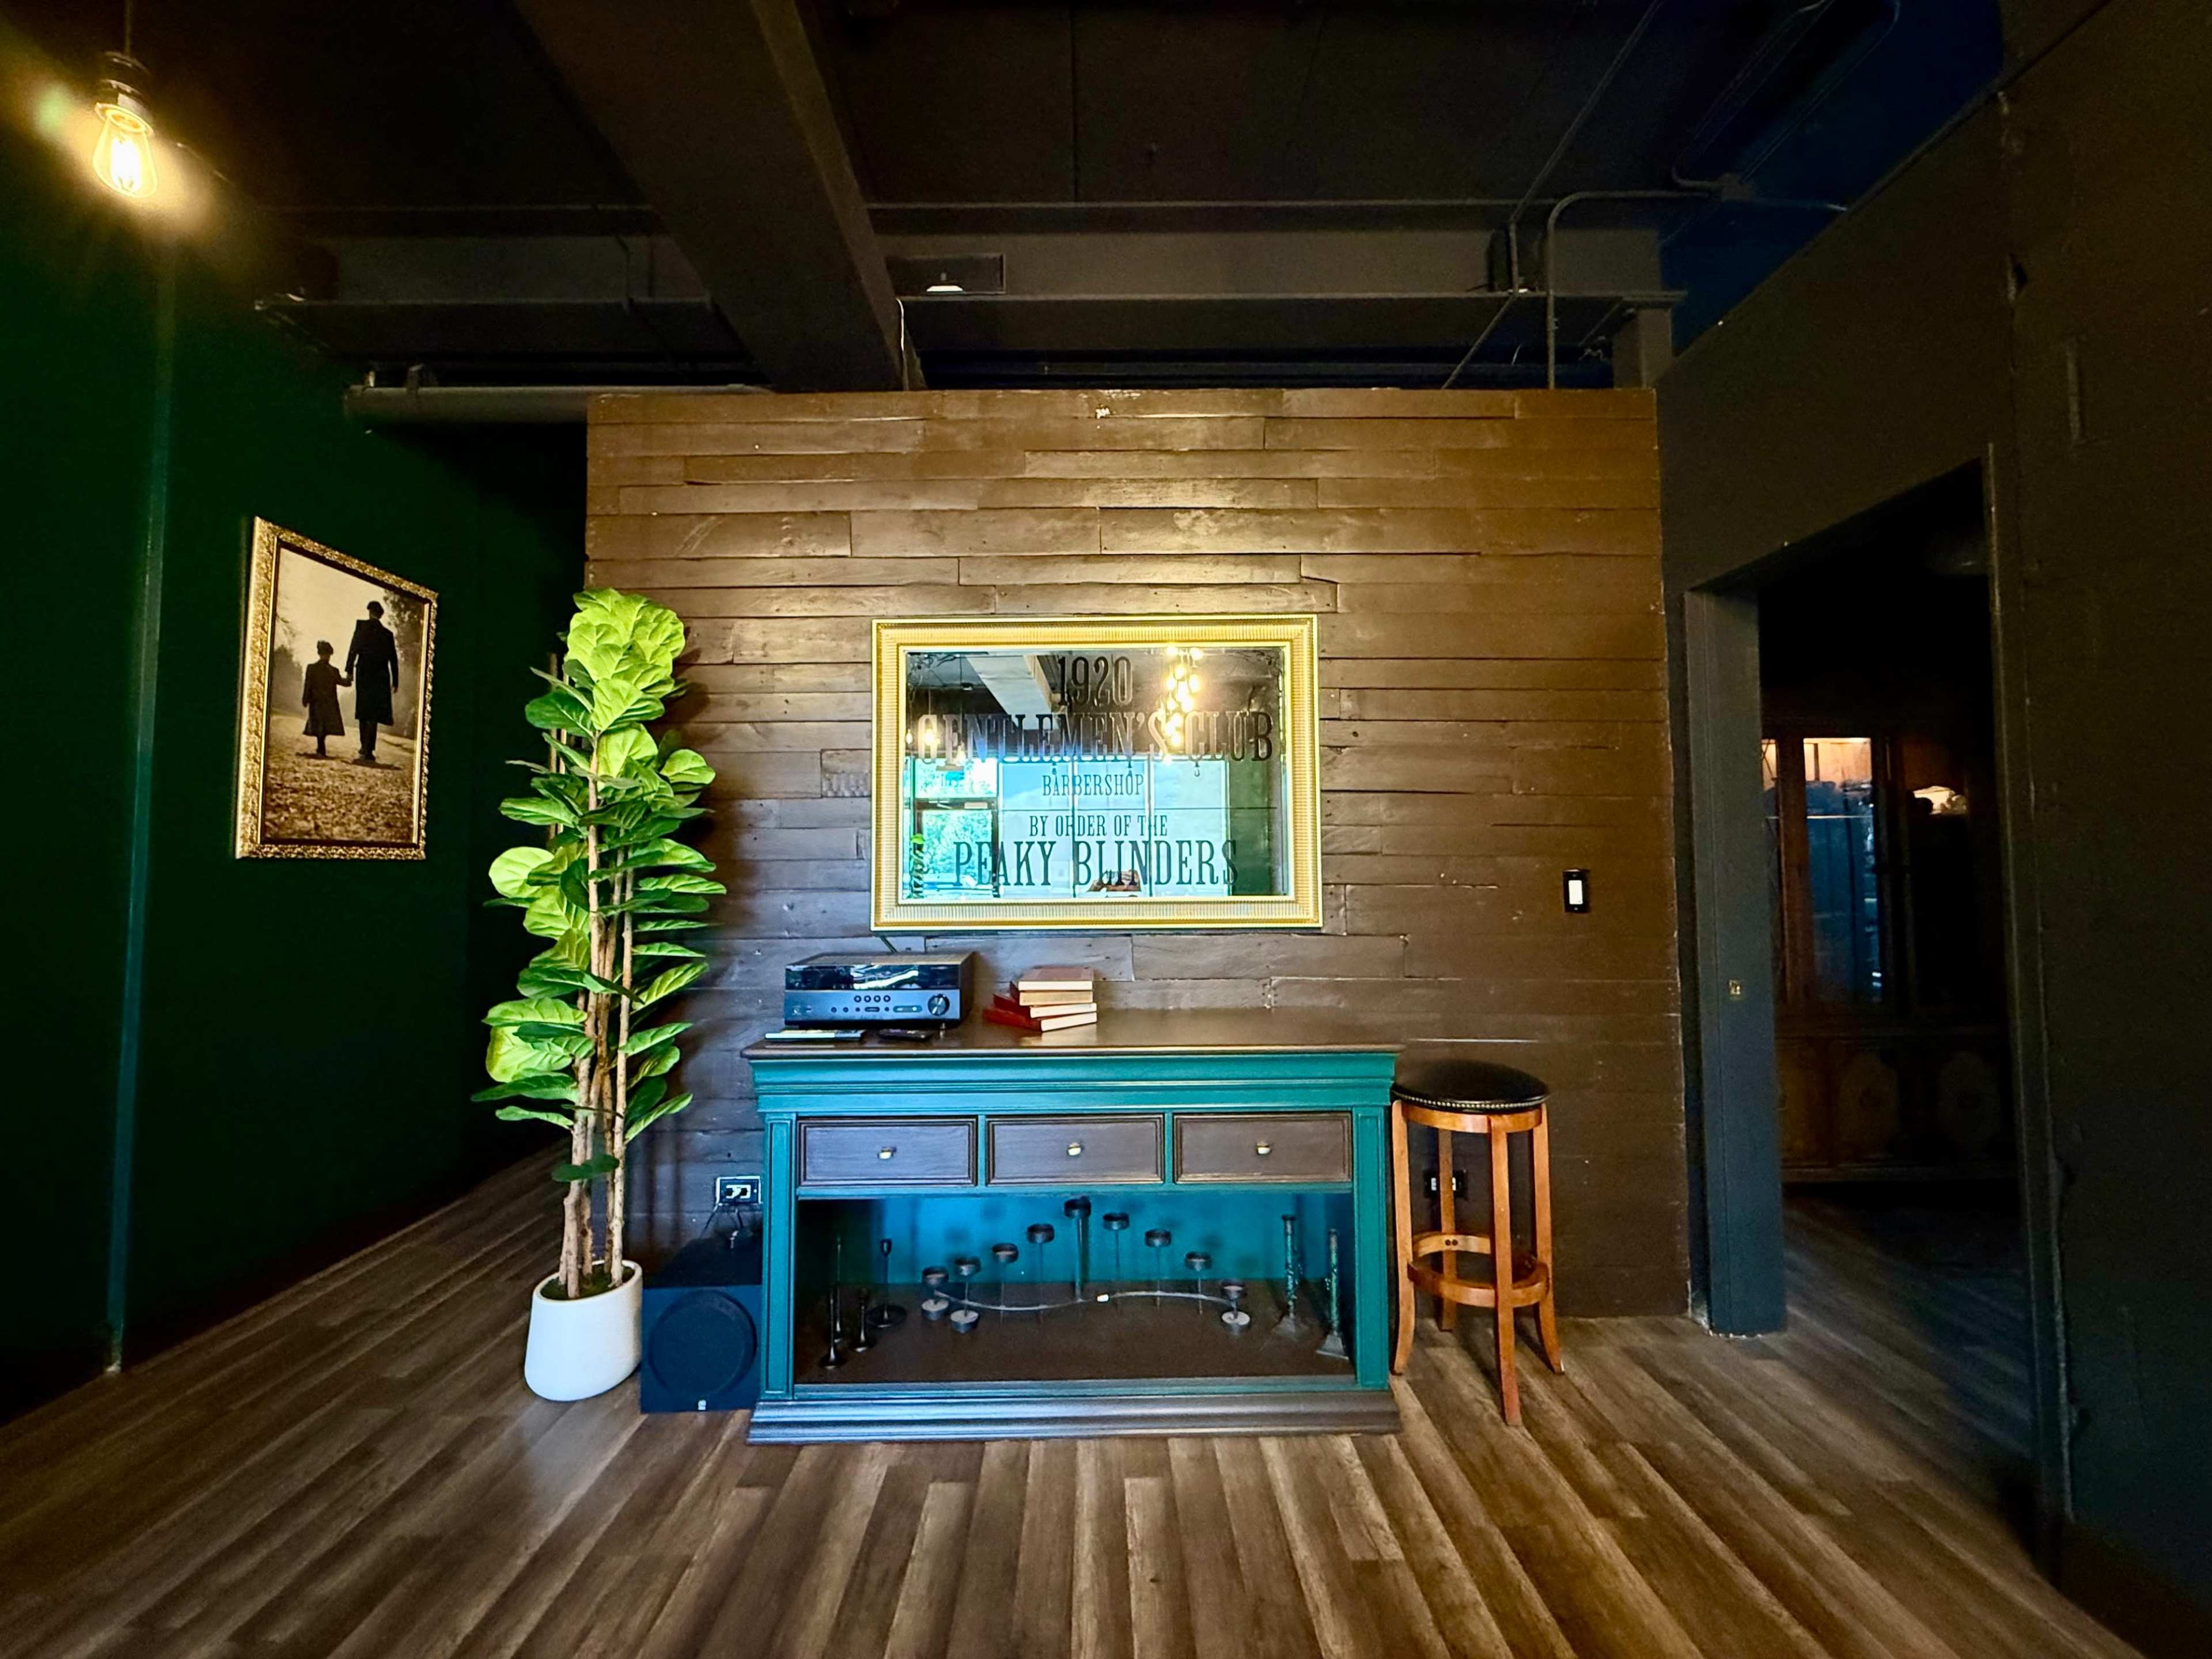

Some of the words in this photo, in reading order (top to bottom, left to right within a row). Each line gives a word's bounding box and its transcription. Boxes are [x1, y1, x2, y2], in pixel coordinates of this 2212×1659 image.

[1058, 656, 1133, 707] 1920
[1184, 711, 1272, 762] CLUB
[1041, 774, 1144, 796] BARBERSHOP
[1029, 815, 1049, 836] BY
[1055, 815, 1107, 836] ORDER
[1113, 815, 1131, 836] OF
[1137, 815, 1168, 836] THE
[953, 840, 1057, 887] PEAKY
[1073, 839, 1238, 886] BLINDERS
